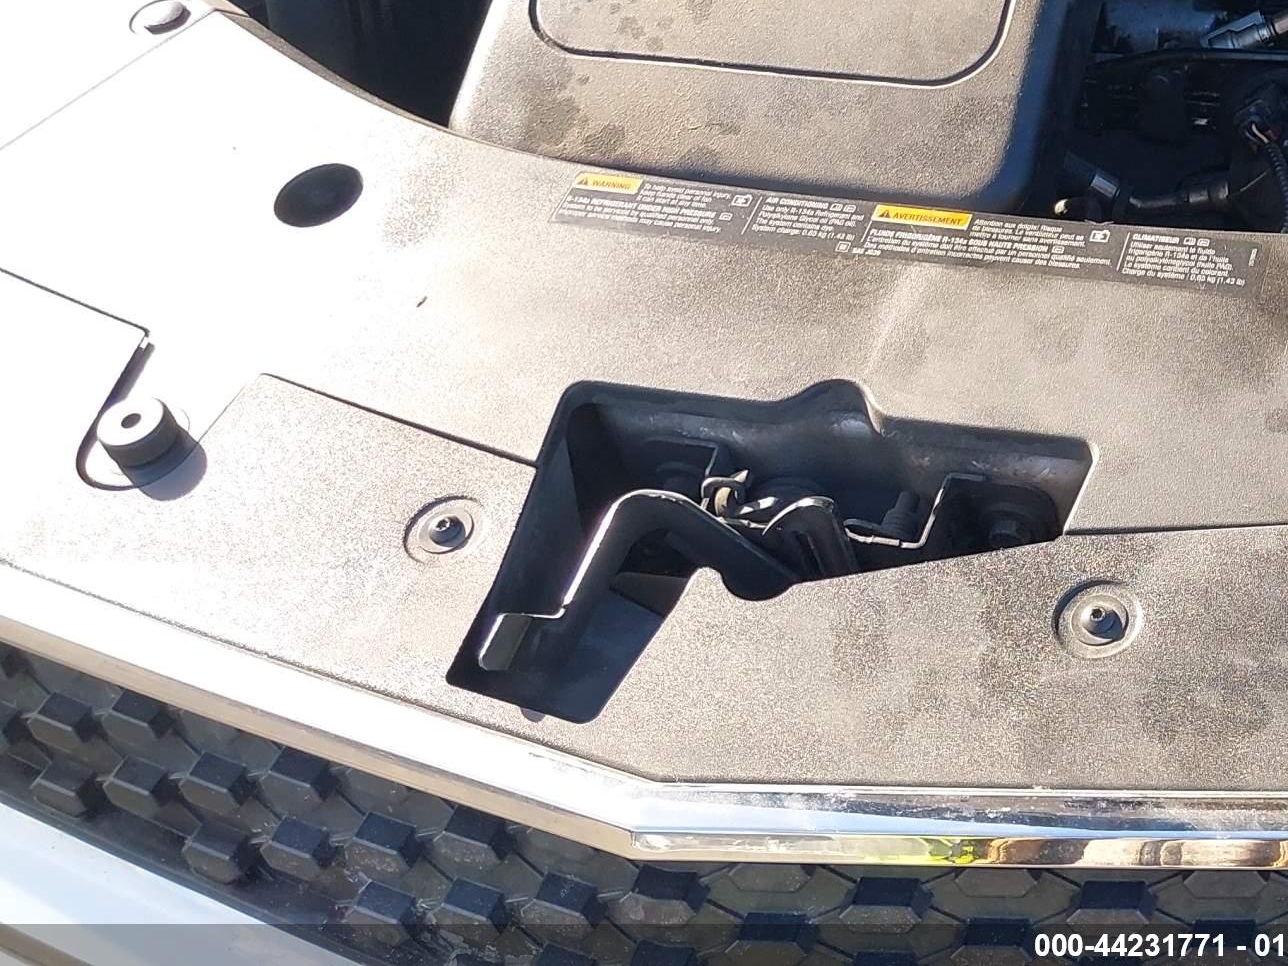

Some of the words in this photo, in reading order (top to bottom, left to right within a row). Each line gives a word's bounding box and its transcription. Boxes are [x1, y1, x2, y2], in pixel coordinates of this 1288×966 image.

[593, 179, 632, 190] WARNING
[780, 198, 829, 209] CONDITIONING
[894, 212, 964, 225] AVERTISSEMENT
